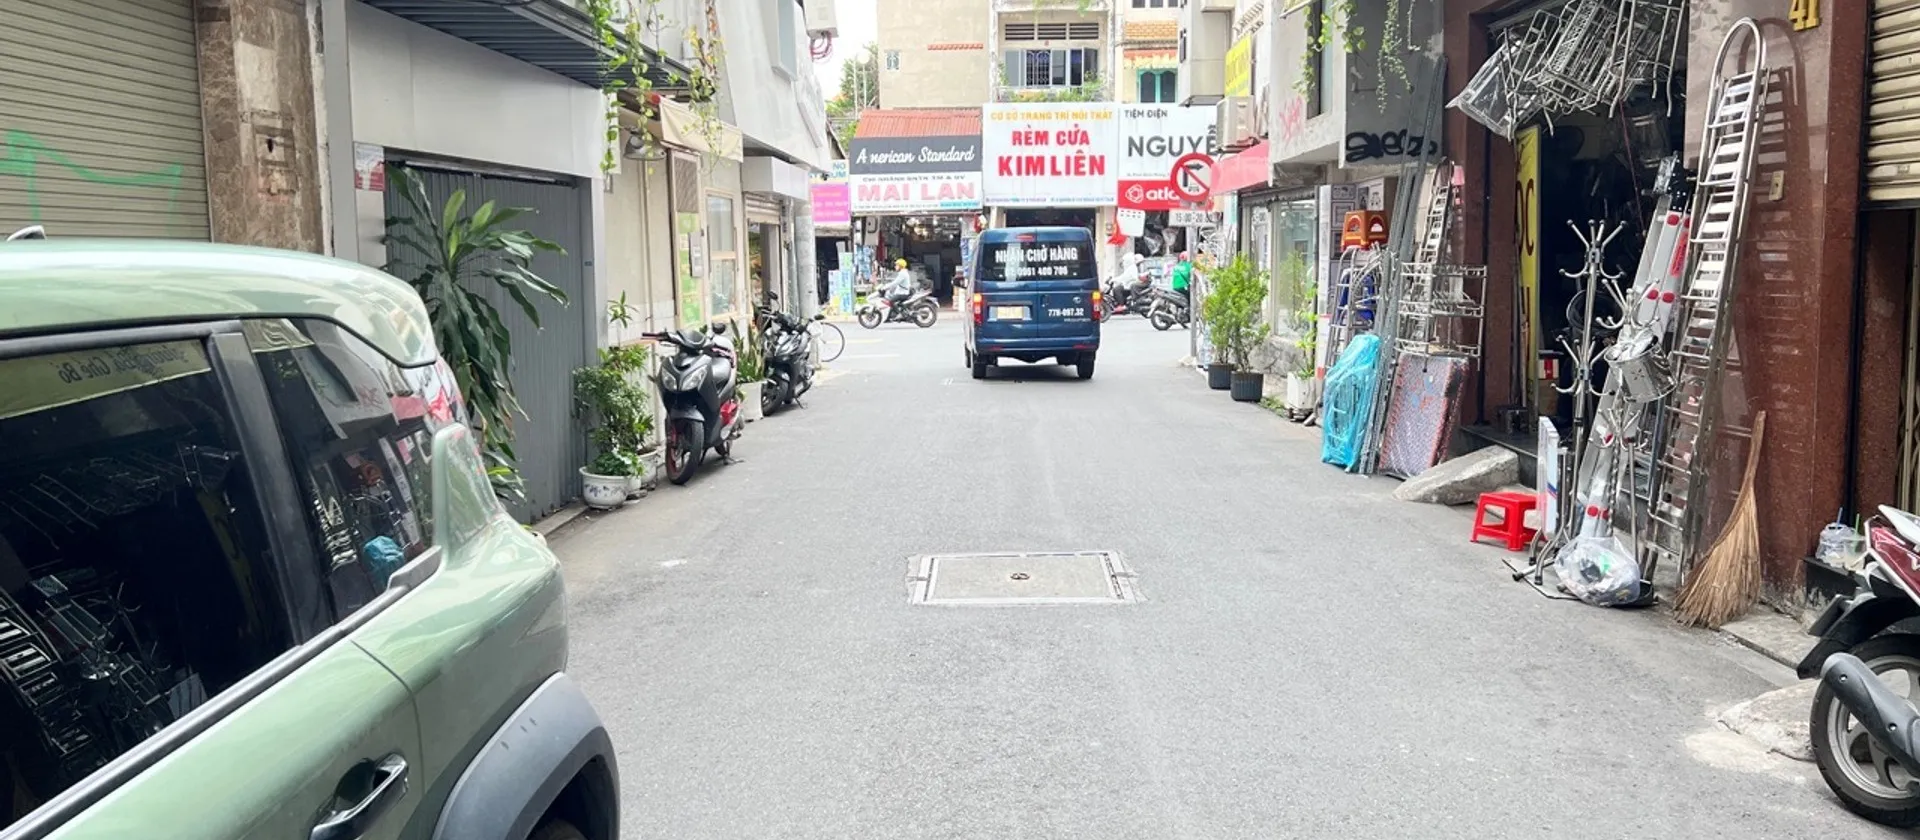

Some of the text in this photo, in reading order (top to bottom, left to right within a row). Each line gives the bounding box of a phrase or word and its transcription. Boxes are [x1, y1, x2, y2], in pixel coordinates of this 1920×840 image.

[1788, 0, 1819, 31] 41
[1021, 111, 1053, 121] TRANG
[1124, 109, 1144, 119] TIỆM
[1012, 123, 1090, 146] RÈM CỬA
[918, 144, 975, 163] Standard
[998, 149, 1105, 177] KIM LIÊN
[858, 182, 975, 201] MAI LAN
[1027, 244, 1048, 262] CHỞ
[1050, 245, 1078, 261] HÀNG
